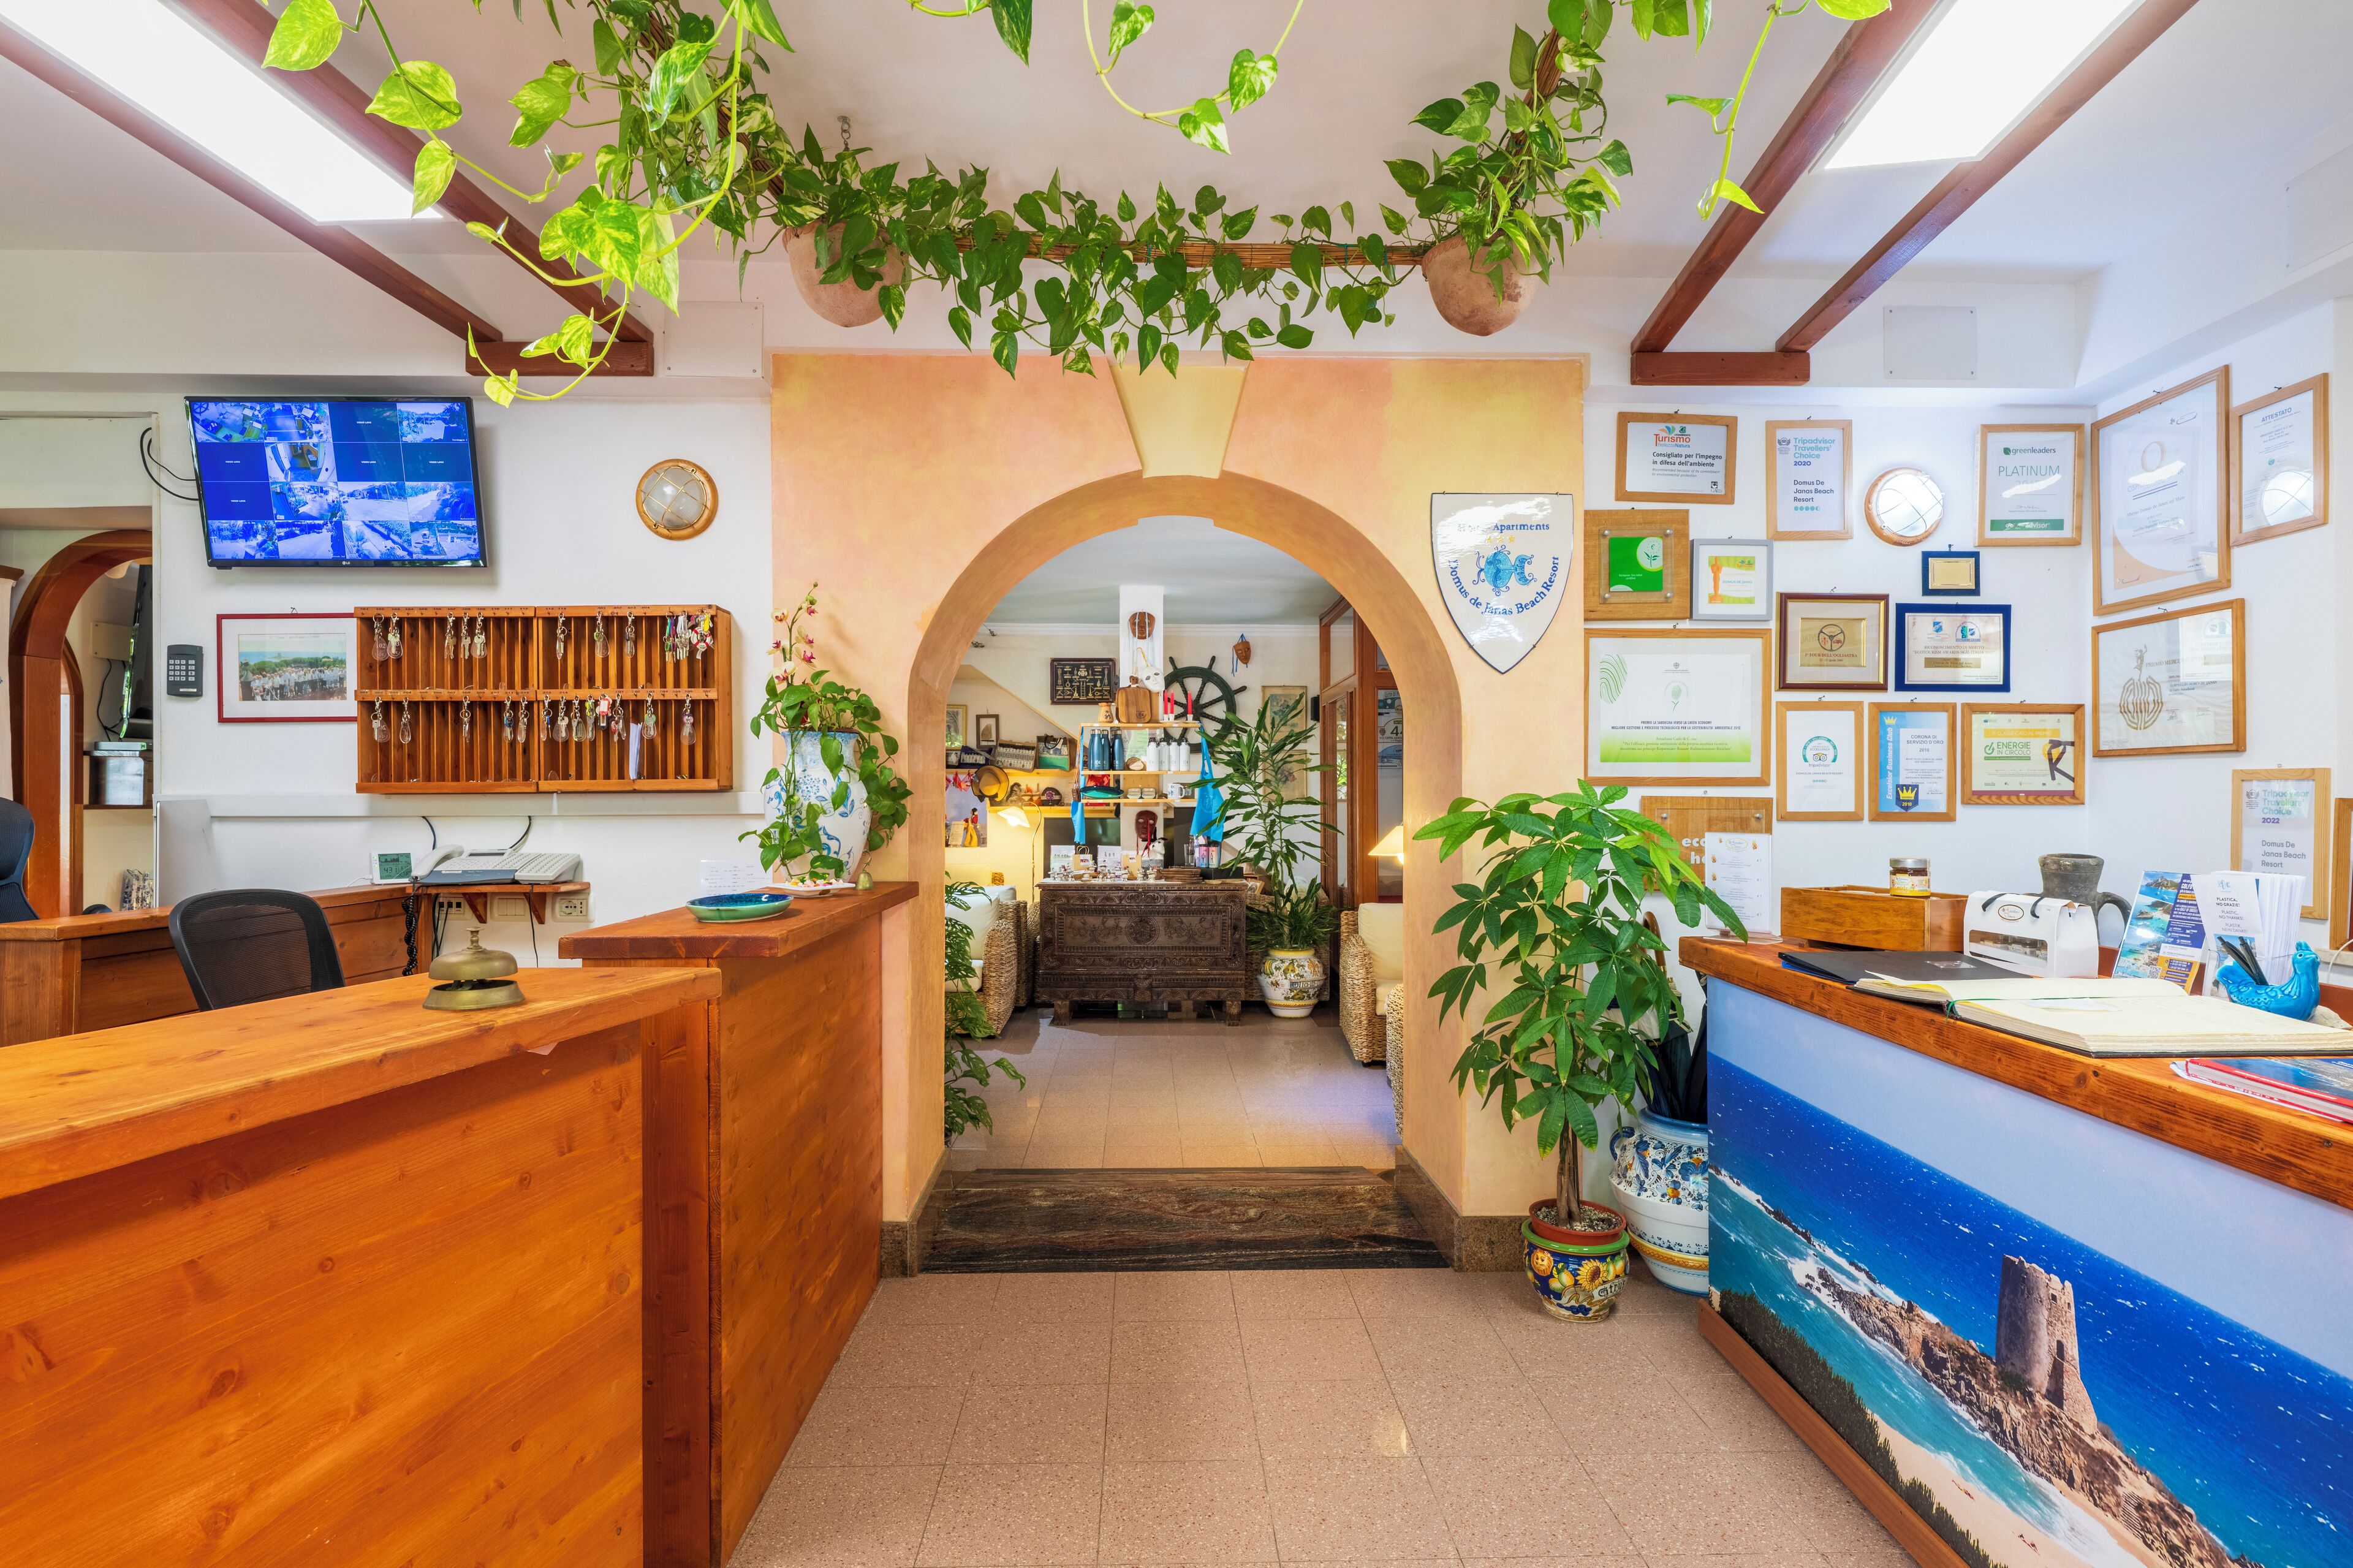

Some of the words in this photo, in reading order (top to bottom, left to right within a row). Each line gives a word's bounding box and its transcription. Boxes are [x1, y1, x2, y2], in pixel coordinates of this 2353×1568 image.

[2261, 407, 2292, 423] ATTESTATO
[1654, 434, 1691, 447] Turismo
[2012, 447, 2056, 455] greenleaders
[1999, 466, 2059, 476] PLATINUM
[1493, 523, 1550, 533] Apartments
[1469, 597, 1482, 609] de
[1481, 602, 1513, 615] Janas
[1514, 590, 1547, 614] Beach
[1541, 556, 1559, 593] Resort
[2262, 798, 2305, 807] Travellers'
[2262, 807, 2292, 816] Choice
[2262, 860, 2284, 868] Resort
